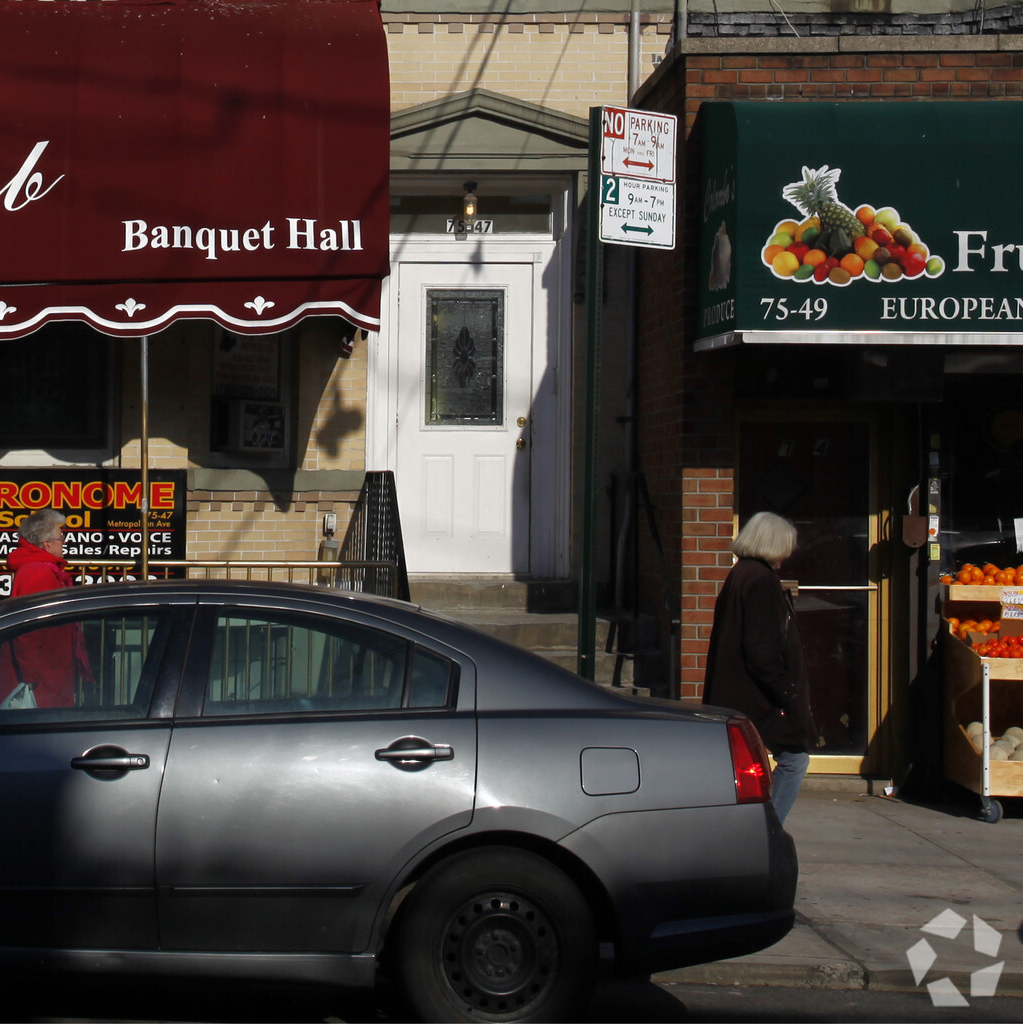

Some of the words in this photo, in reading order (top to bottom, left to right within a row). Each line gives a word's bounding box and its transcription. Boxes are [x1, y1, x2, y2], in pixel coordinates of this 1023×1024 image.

[604, 110, 624, 136] NO
[630, 117, 670, 135] PARKING
[622, 146, 635, 154] MON
[646, 149, 655, 157] FRI
[605, 177, 616, 202] 2
[623, 181, 641, 190] HOUR
[642, 183, 669, 193] PARKING
[608, 207, 635, 220] EXCEPT
[639, 210, 667, 223] SUNDAY
[121, 219, 276, 260] Banquet
[285, 217, 365, 252] Hall
[703, 298, 735, 327] PRODUCE
[760, 297, 828, 321] 75-49
[157, 520, 171, 528] Ave
[118, 532, 172, 543] VOCE
